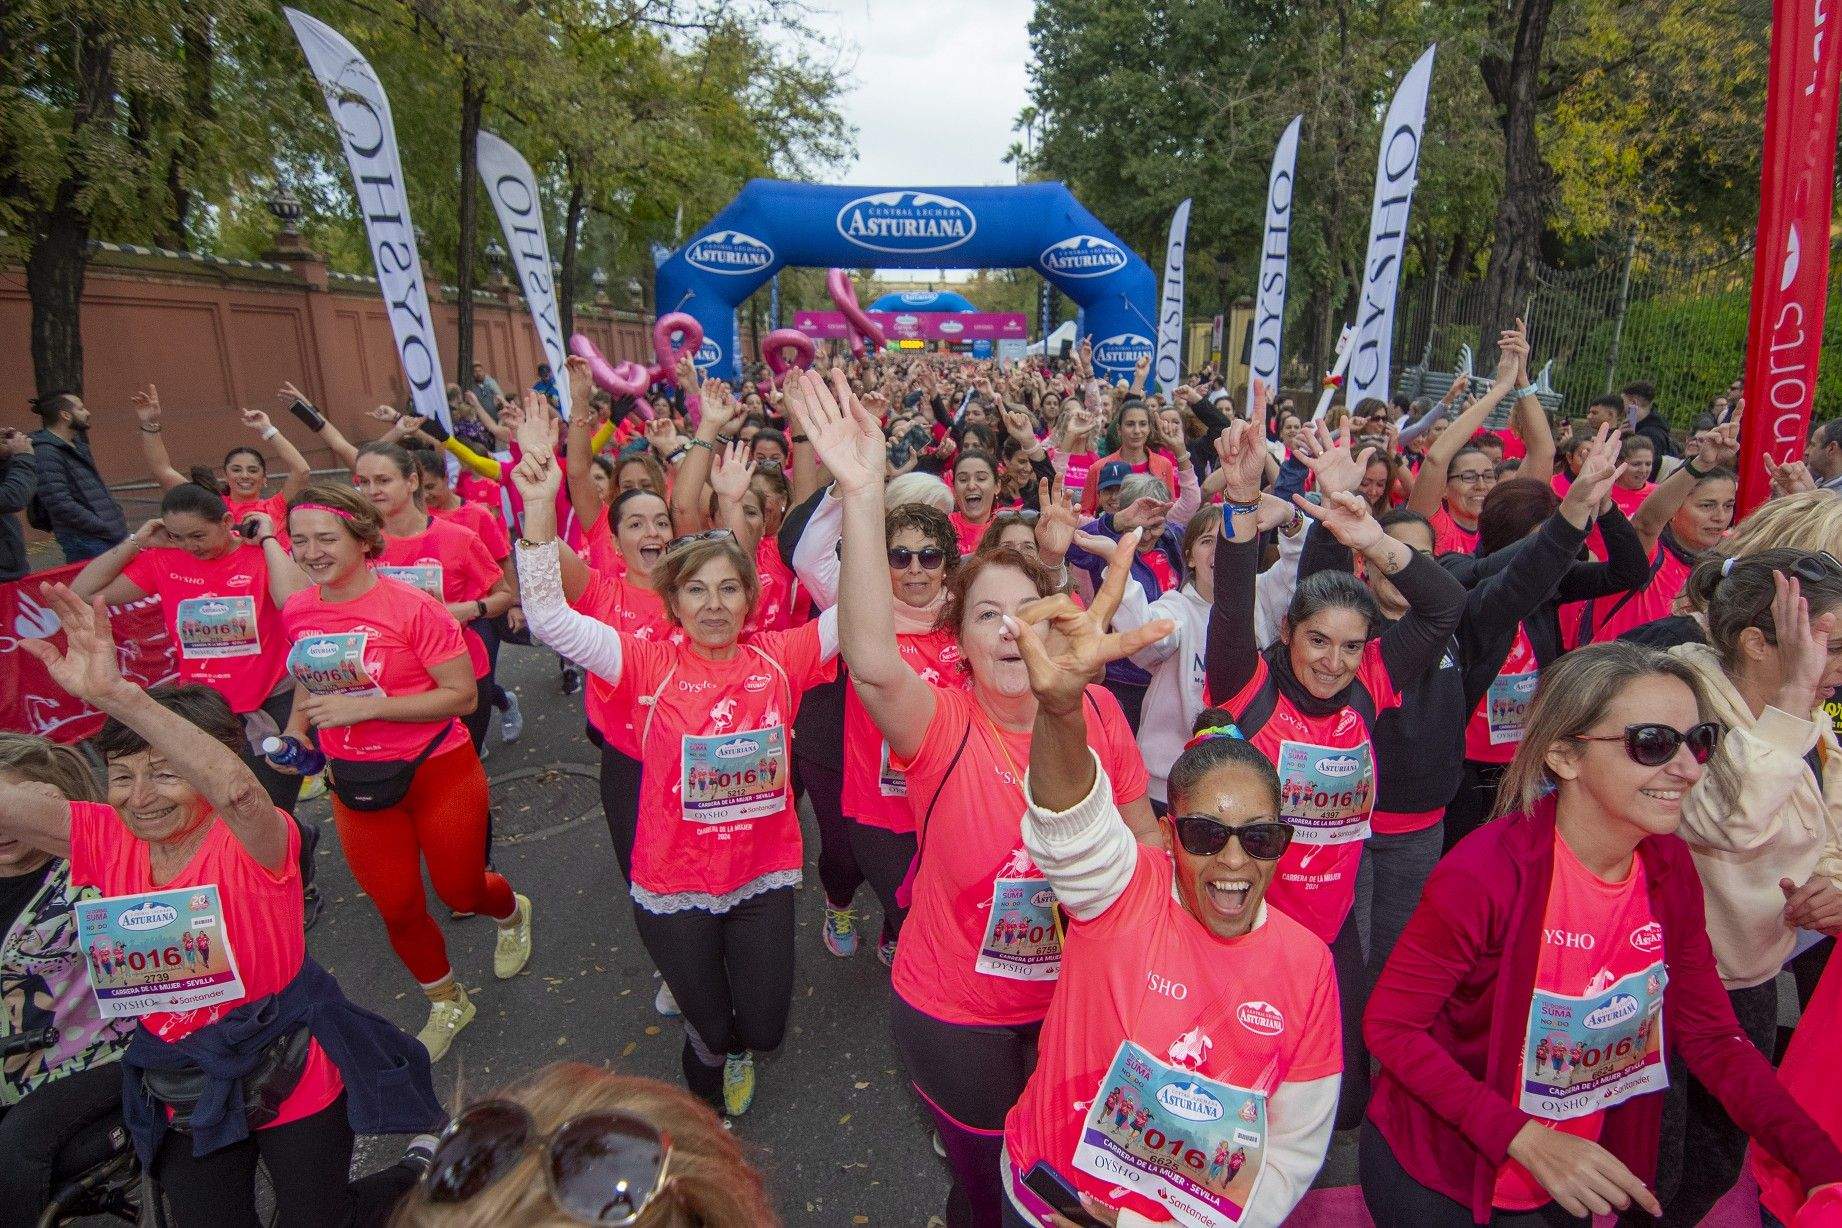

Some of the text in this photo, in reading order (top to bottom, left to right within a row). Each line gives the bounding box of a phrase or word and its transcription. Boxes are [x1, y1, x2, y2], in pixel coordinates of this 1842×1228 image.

[868, 207, 961, 216] CENTRAL LECHERA
[849, 209, 966, 237] ASTURIANA
[690, 245, 768, 266] ASTURIANA
[1047, 252, 1122, 269] ASTURIANA
[1354, 124, 1417, 390] OYSHO
[1254, 170, 1291, 378] OYSHO
[1157, 241, 1184, 383] OYSHO
[202, 624, 230, 635] 016
[314, 668, 342, 683] 016
[719, 745, 757, 756] ASTURIANA
[1319, 761, 1357, 772] ASTURIANA
[719, 769, 757, 787] 016
[728, 788, 746, 797] 5212
[1314, 791, 1353, 808] 016
[694, 809, 728, 819] OYSHO
[1287, 816, 1312, 825] CARRERA
[1320, 811, 1340, 819] 4397
[1281, 873, 1308, 882] CARRERA
[1308, 875, 1316, 883] DE
[1316, 874, 1324, 883] LA
[121, 912, 175, 927] ASTURIANA
[1543, 928, 1595, 950] YSHO
[128, 946, 182, 971] 016
[1000, 952, 1026, 963] CARRERA
[1036, 945, 1057, 955] 6759
[992, 960, 1033, 975] OYSHO
[111, 986, 141, 996] CARRERA
[150, 984, 159, 992] LA
[159, 982, 181, 991] MUJER
[186, 976, 215, 988] SEVILLA
[144, 972, 170, 984] 2739
[112, 988, 225, 1012] OYSHO Santander
[1240, 1010, 1282, 1030] ASTURIANA
[1541, 1006, 1572, 1019] SUMA
[1582, 1036, 1632, 1068] 016
[1125, 1058, 1151, 1081] SUMA
[1581, 1082, 1591, 1090] DE
[1592, 1080, 1600, 1088] LA
[1600, 1072, 1621, 1084] MUJER
[1161, 1089, 1218, 1118] ASTURIANA
[1542, 1096, 1588, 1113] OYSHO
[1143, 1128, 1207, 1170] 016
[1094, 1155, 1140, 1182] OYSHO
[1149, 1155, 1180, 1171] 6625
[1103, 1138, 1221, 1207] CARRERA DE LA MUJER SEVILLA
[1168, 1195, 1217, 1228] Santander
